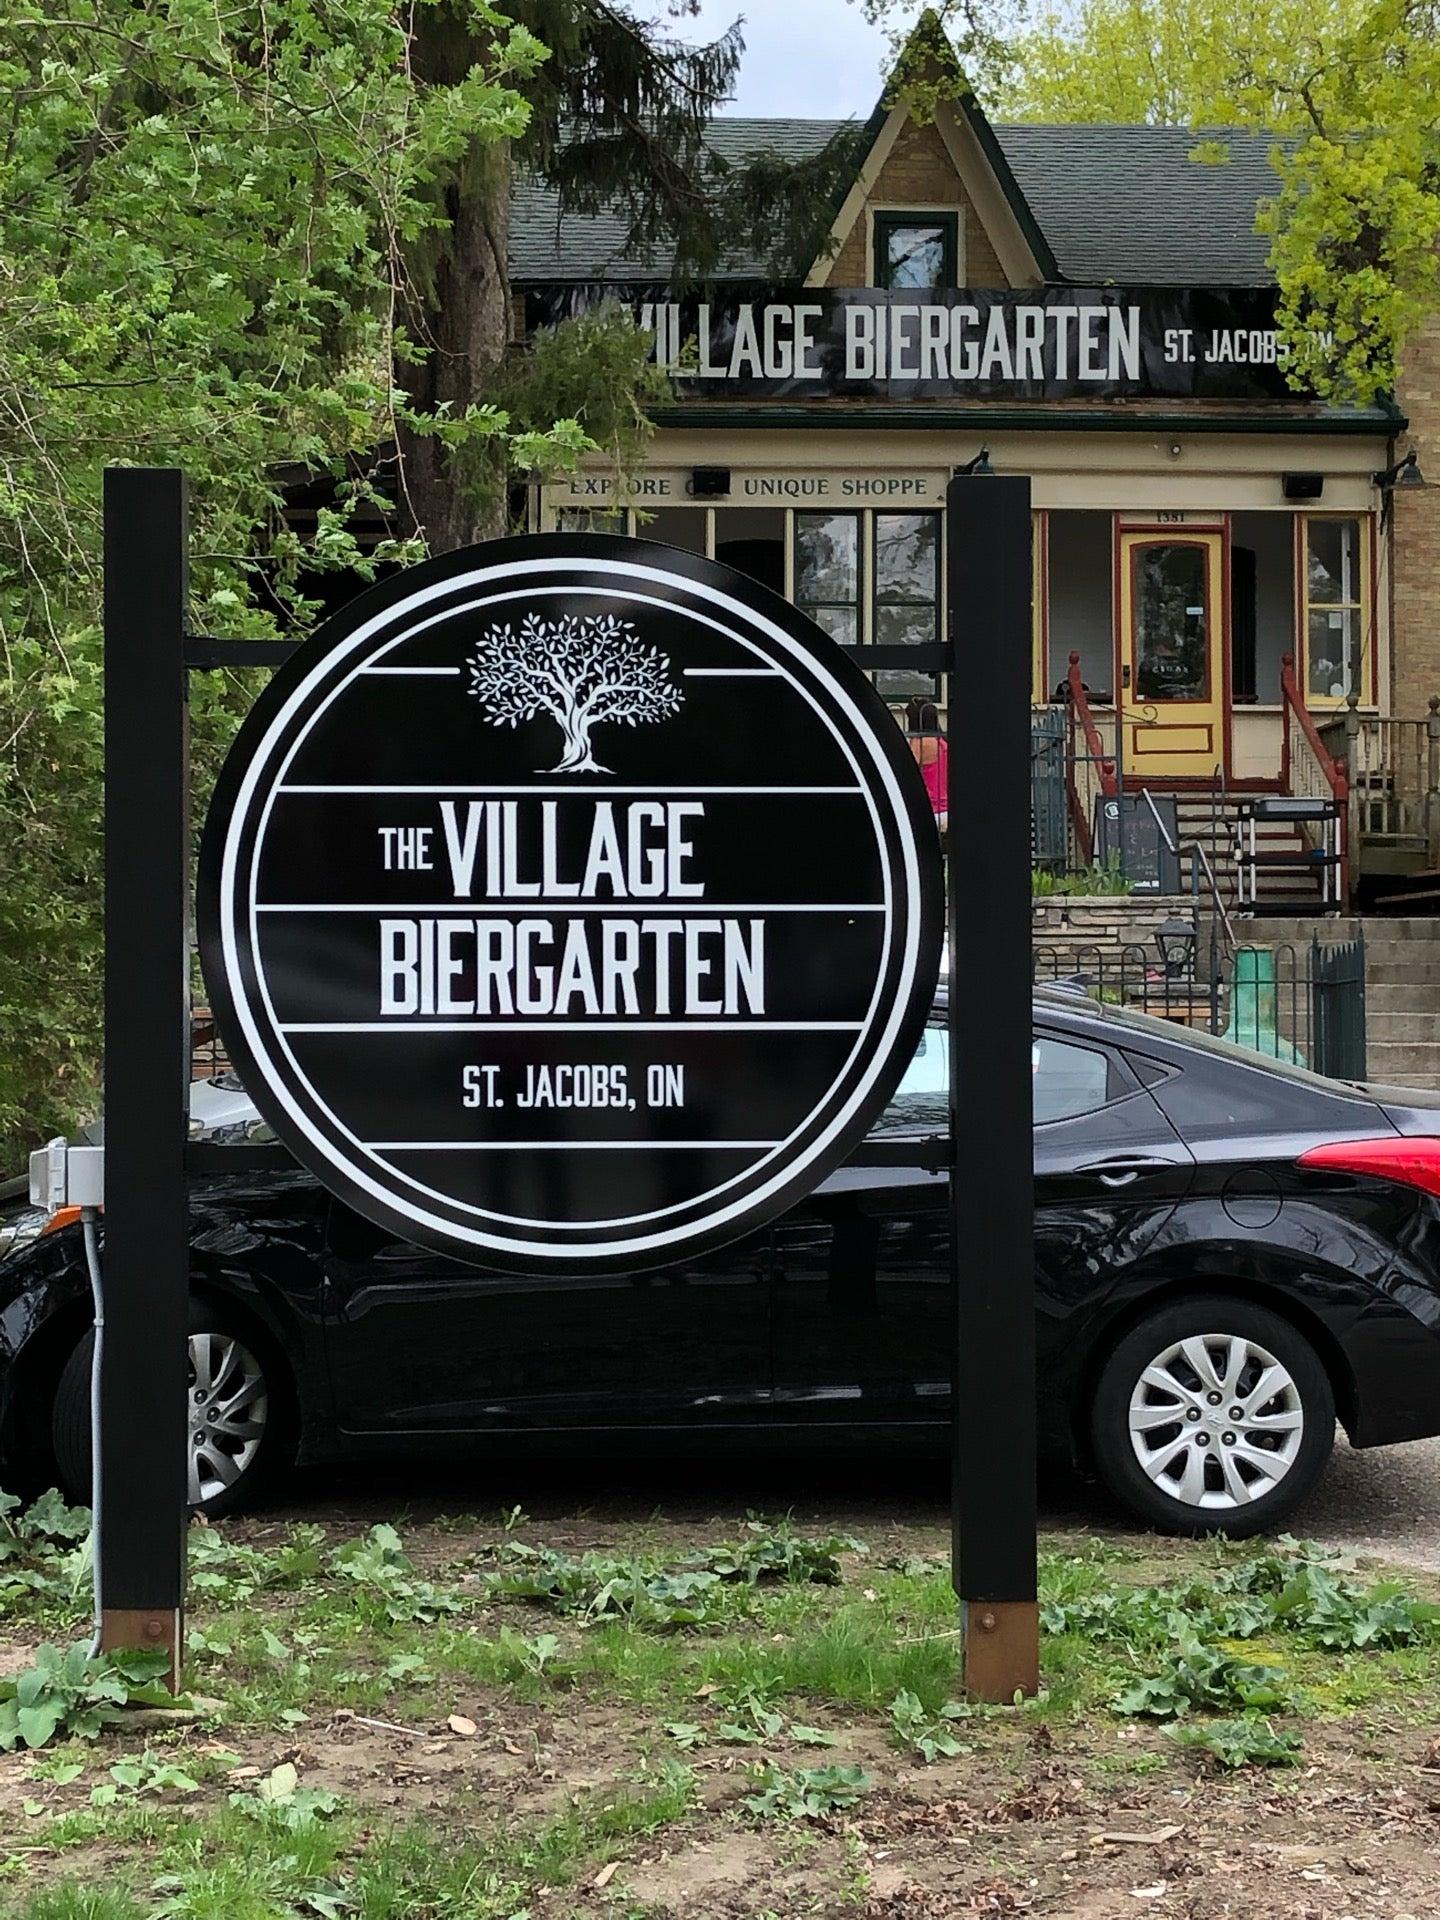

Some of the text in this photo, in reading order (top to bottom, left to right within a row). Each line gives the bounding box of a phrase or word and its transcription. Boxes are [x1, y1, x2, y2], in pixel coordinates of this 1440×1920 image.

[620, 302, 823, 379] ILLAGE
[845, 304, 1140, 380] BIERGARTEN
[1164, 329, 1196, 363] ST.
[570, 478, 671, 495] EXPORE
[744, 478, 829, 497] UNIQUE
[842, 478, 927, 496] SHOPPE
[378, 800, 706, 898] THE VILLAGE
[379, 919, 766, 1016] BIERGARTEN
[463, 1065, 685, 1113] ST. JACOBS, ON
